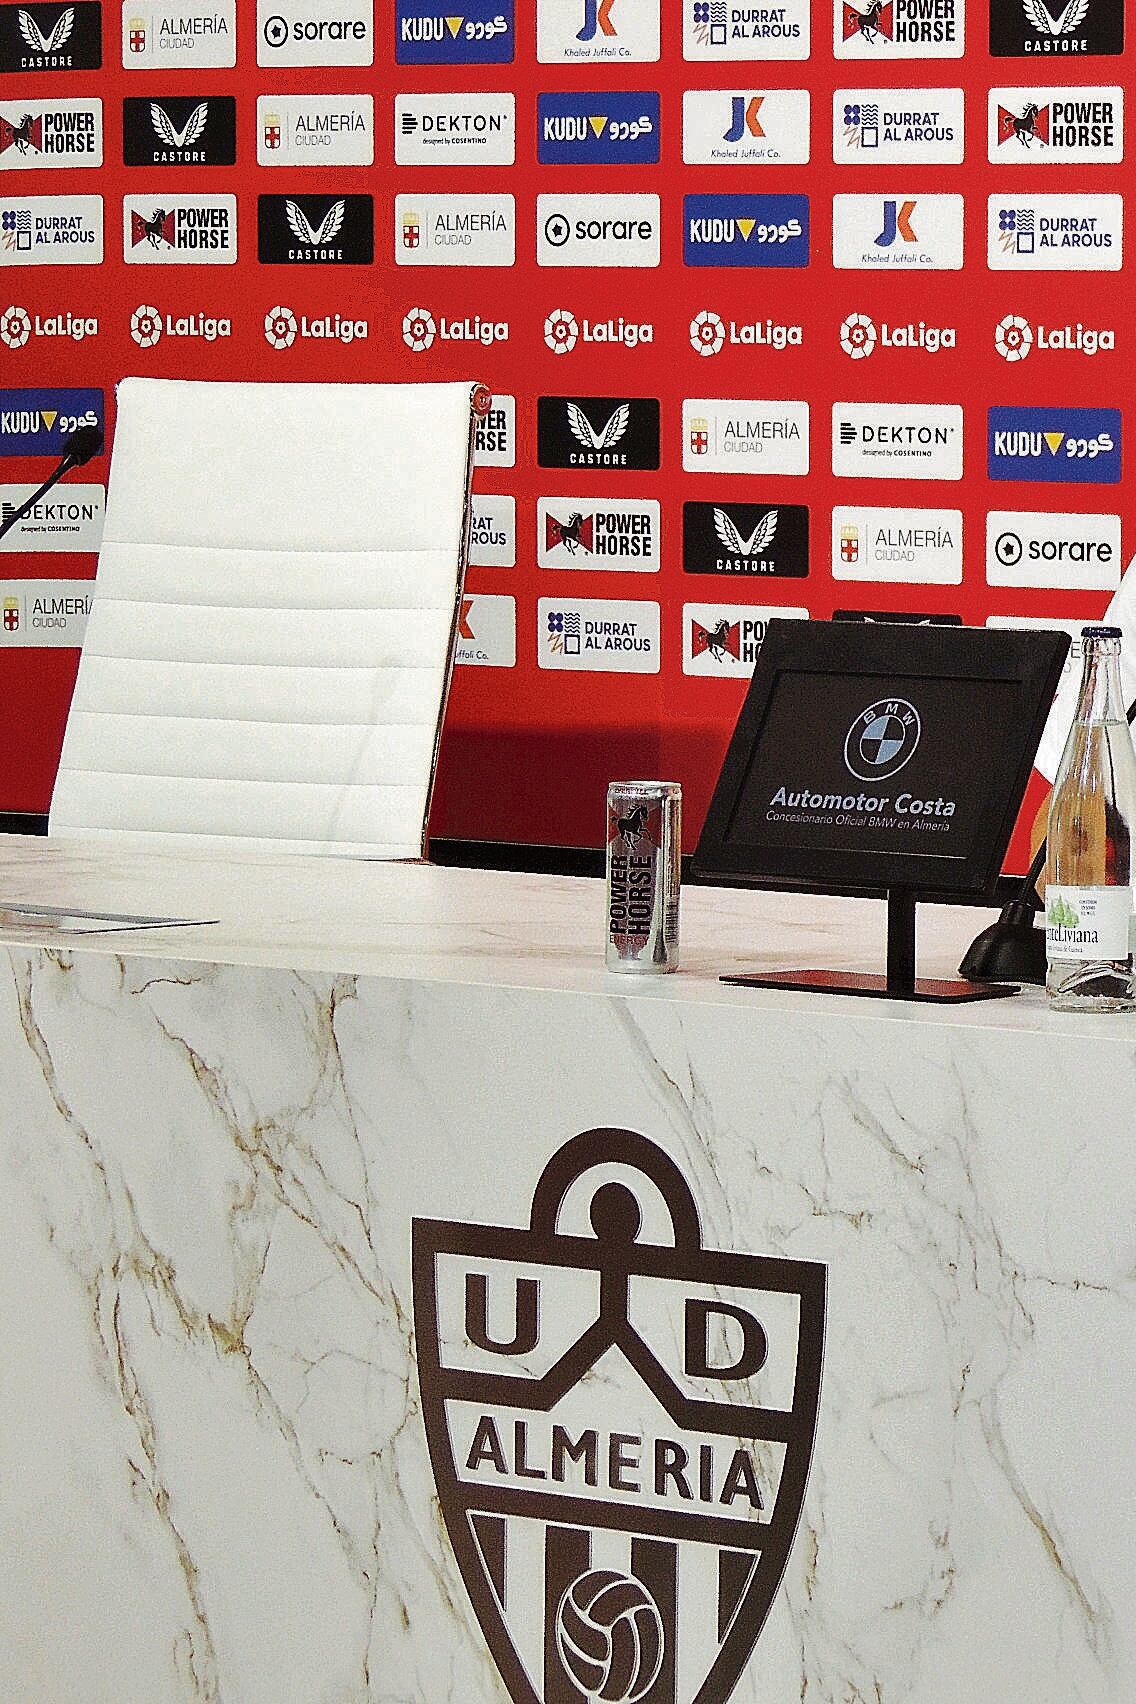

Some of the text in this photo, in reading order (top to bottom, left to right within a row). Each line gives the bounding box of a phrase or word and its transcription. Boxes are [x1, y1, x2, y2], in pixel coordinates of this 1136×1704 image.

[732, 9, 786, 22] DURRAT
[896, 0, 955, 19] POWER
[160, 14, 228, 34] ALMERÍA
[294, 21, 366, 40] sorare
[402, 18, 443, 40] KUDU
[732, 24, 800, 38] AL AROUS
[896, 21, 955, 42] HORSE
[160, 38, 194, 48] CIUDAD
[565, 48, 631, 56] Khaled Juffali Co.
[1025, 40, 1087, 51] CASTORE
[21, 57, 73, 67] CASTORE
[45, 113, 94, 132] POWER
[296, 111, 365, 131] ALMERÍA
[423, 115, 500, 131] DEKTON
[884, 113, 939, 125] DURRAT
[1053, 103, 1113, 124] POWER
[544, 117, 587, 140] KUDU
[884, 128, 953, 141] AL AROUS
[1053, 126, 1113, 147] HORSE
[45, 133, 94, 153] HORSE
[296, 135, 331, 146] CIUDAD
[154, 152, 205, 161] CASTORE
[741, 149, 764, 158] Juffali
[768, 149, 780, 157] Co.
[36, 217, 82, 229] DURRAT
[178, 208, 228, 227] POWER
[436, 211, 506, 230] ALMERÍA
[1040, 218, 1097, 231] DURRAT
[36, 231, 94, 244] AL AROUS
[178, 229, 229, 248] HORSE
[435, 235, 471, 245] CIUDAD
[576, 221, 652, 240] sorare
[690, 219, 734, 242] KUDU
[1040, 234, 1112, 247] AL AROUS
[289, 250, 342, 259] CASTORE
[862, 254, 933, 262] Khaled Juffali Co.
[35, 312, 97, 340] LaLiga
[167, 313, 231, 341] LaLiga
[302, 314, 367, 343] LaLiga
[440, 316, 508, 345] LaLiga
[583, 318, 653, 347] LaLiga
[730, 320, 802, 349] LaLiga
[882, 322, 955, 352] LaLiga
[1038, 324, 1114, 355] LaLiga
[1, 411, 40, 433] KUDU
[725, 419, 800, 438] ALMERÍA
[863, 426, 947, 444] DEKTON
[995, 432, 1042, 456] KUDU
[724, 442, 762, 453] CIUDAD
[570, 454, 626, 464] CASTORE
[596, 513, 650, 534] POWER
[472, 531, 506, 545] ROUS
[596, 535, 651, 556] HORSE
[876, 527, 953, 548] ALMERÍA
[875, 550, 914, 561] CIUDAD
[1029, 541, 1112, 562] sorare
[717, 560, 774, 571] CASTORE
[32, 618, 66, 628] CIUDAD
[585, 622, 637, 636] DURRAT
[585, 636, 650, 651] AL AROUS
[863, 703, 915, 726] BMW
[770, 787, 956, 816] Automotor Costa
[766, 811, 833, 824] Concesionario
[835, 815, 866, 826] Oficial
[868, 816, 896, 828] BMW
[897, 819, 910, 829] en
[610, 855, 651, 934] POWER HORSE
[466, 1273, 769, 1381] U D
[466, 1416, 765, 1511] ALMERIA
